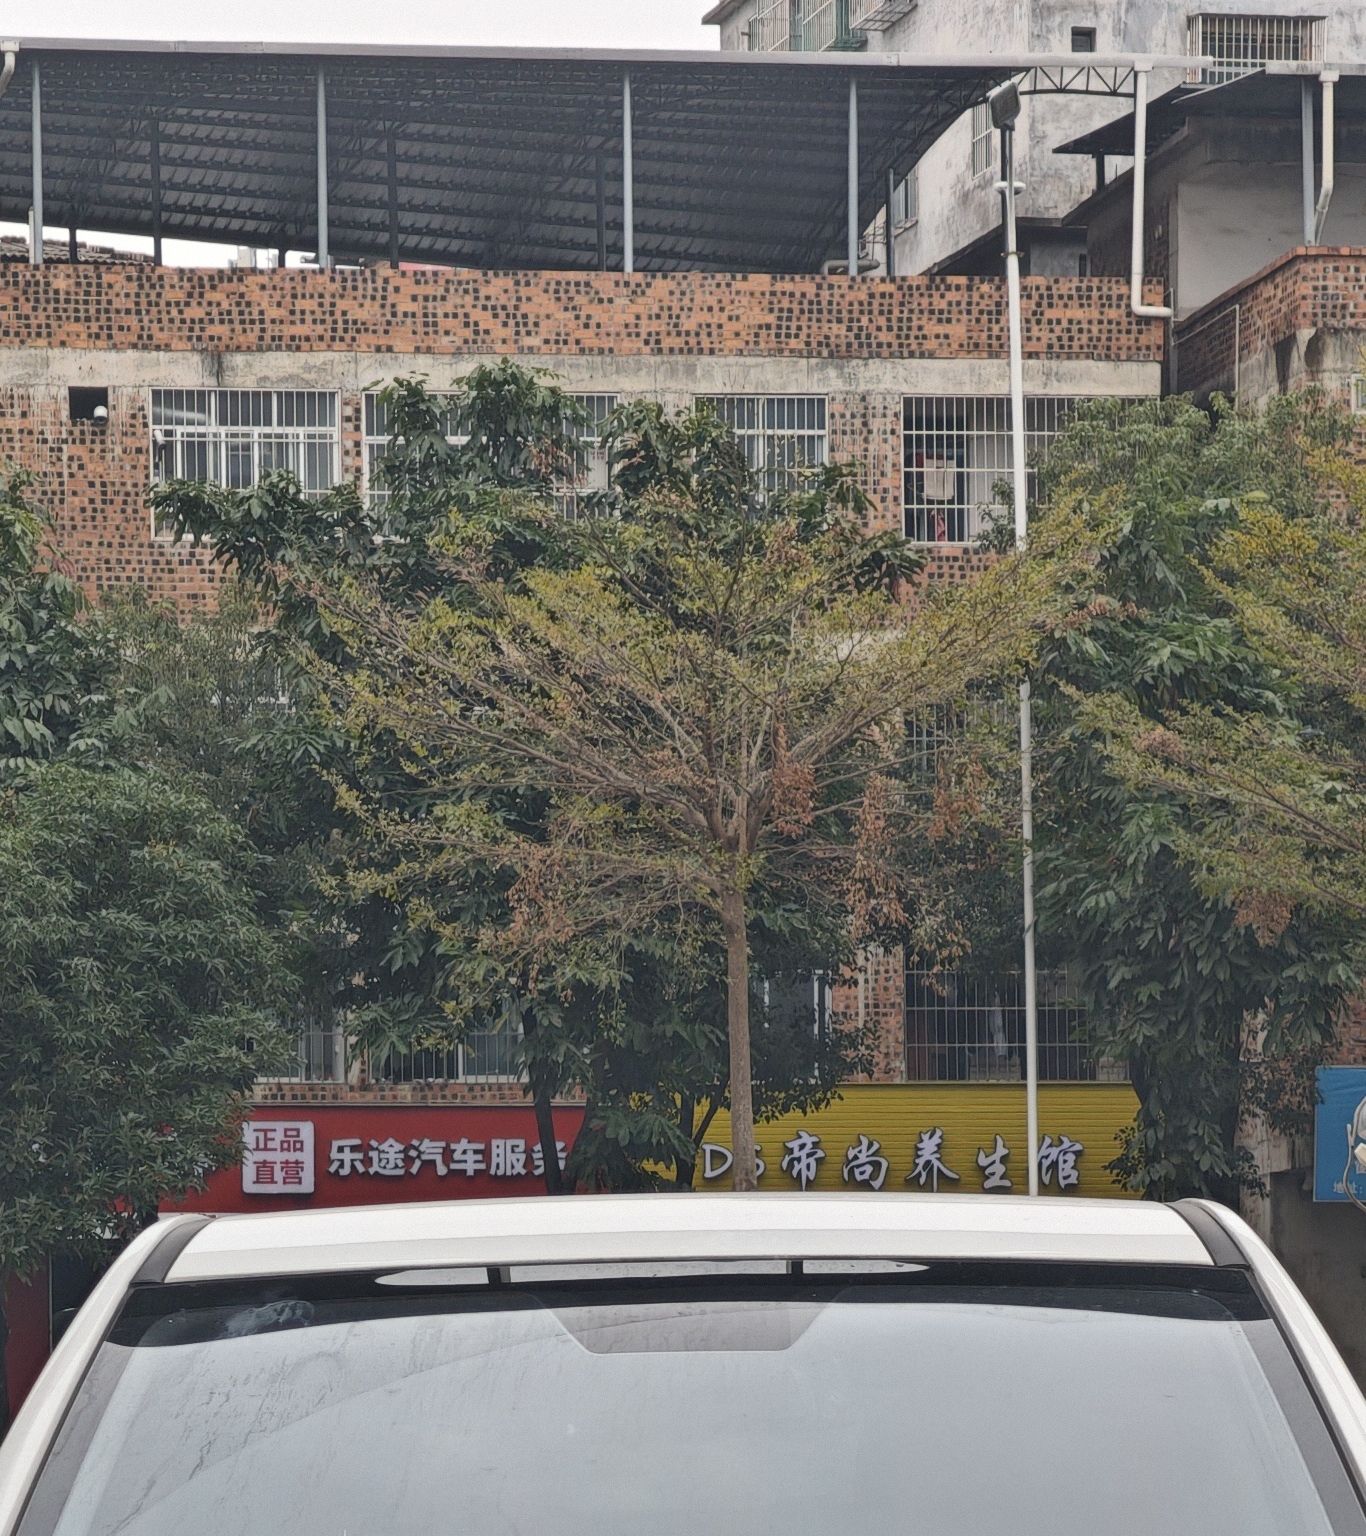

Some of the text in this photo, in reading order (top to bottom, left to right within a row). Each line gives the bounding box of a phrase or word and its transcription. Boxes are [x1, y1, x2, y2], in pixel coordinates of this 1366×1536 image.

[252, 1127, 305, 1153] 正品
[251, 1158, 305, 1185] 直营
[781, 1127, 1084, 1191] 帝尚养生馆
